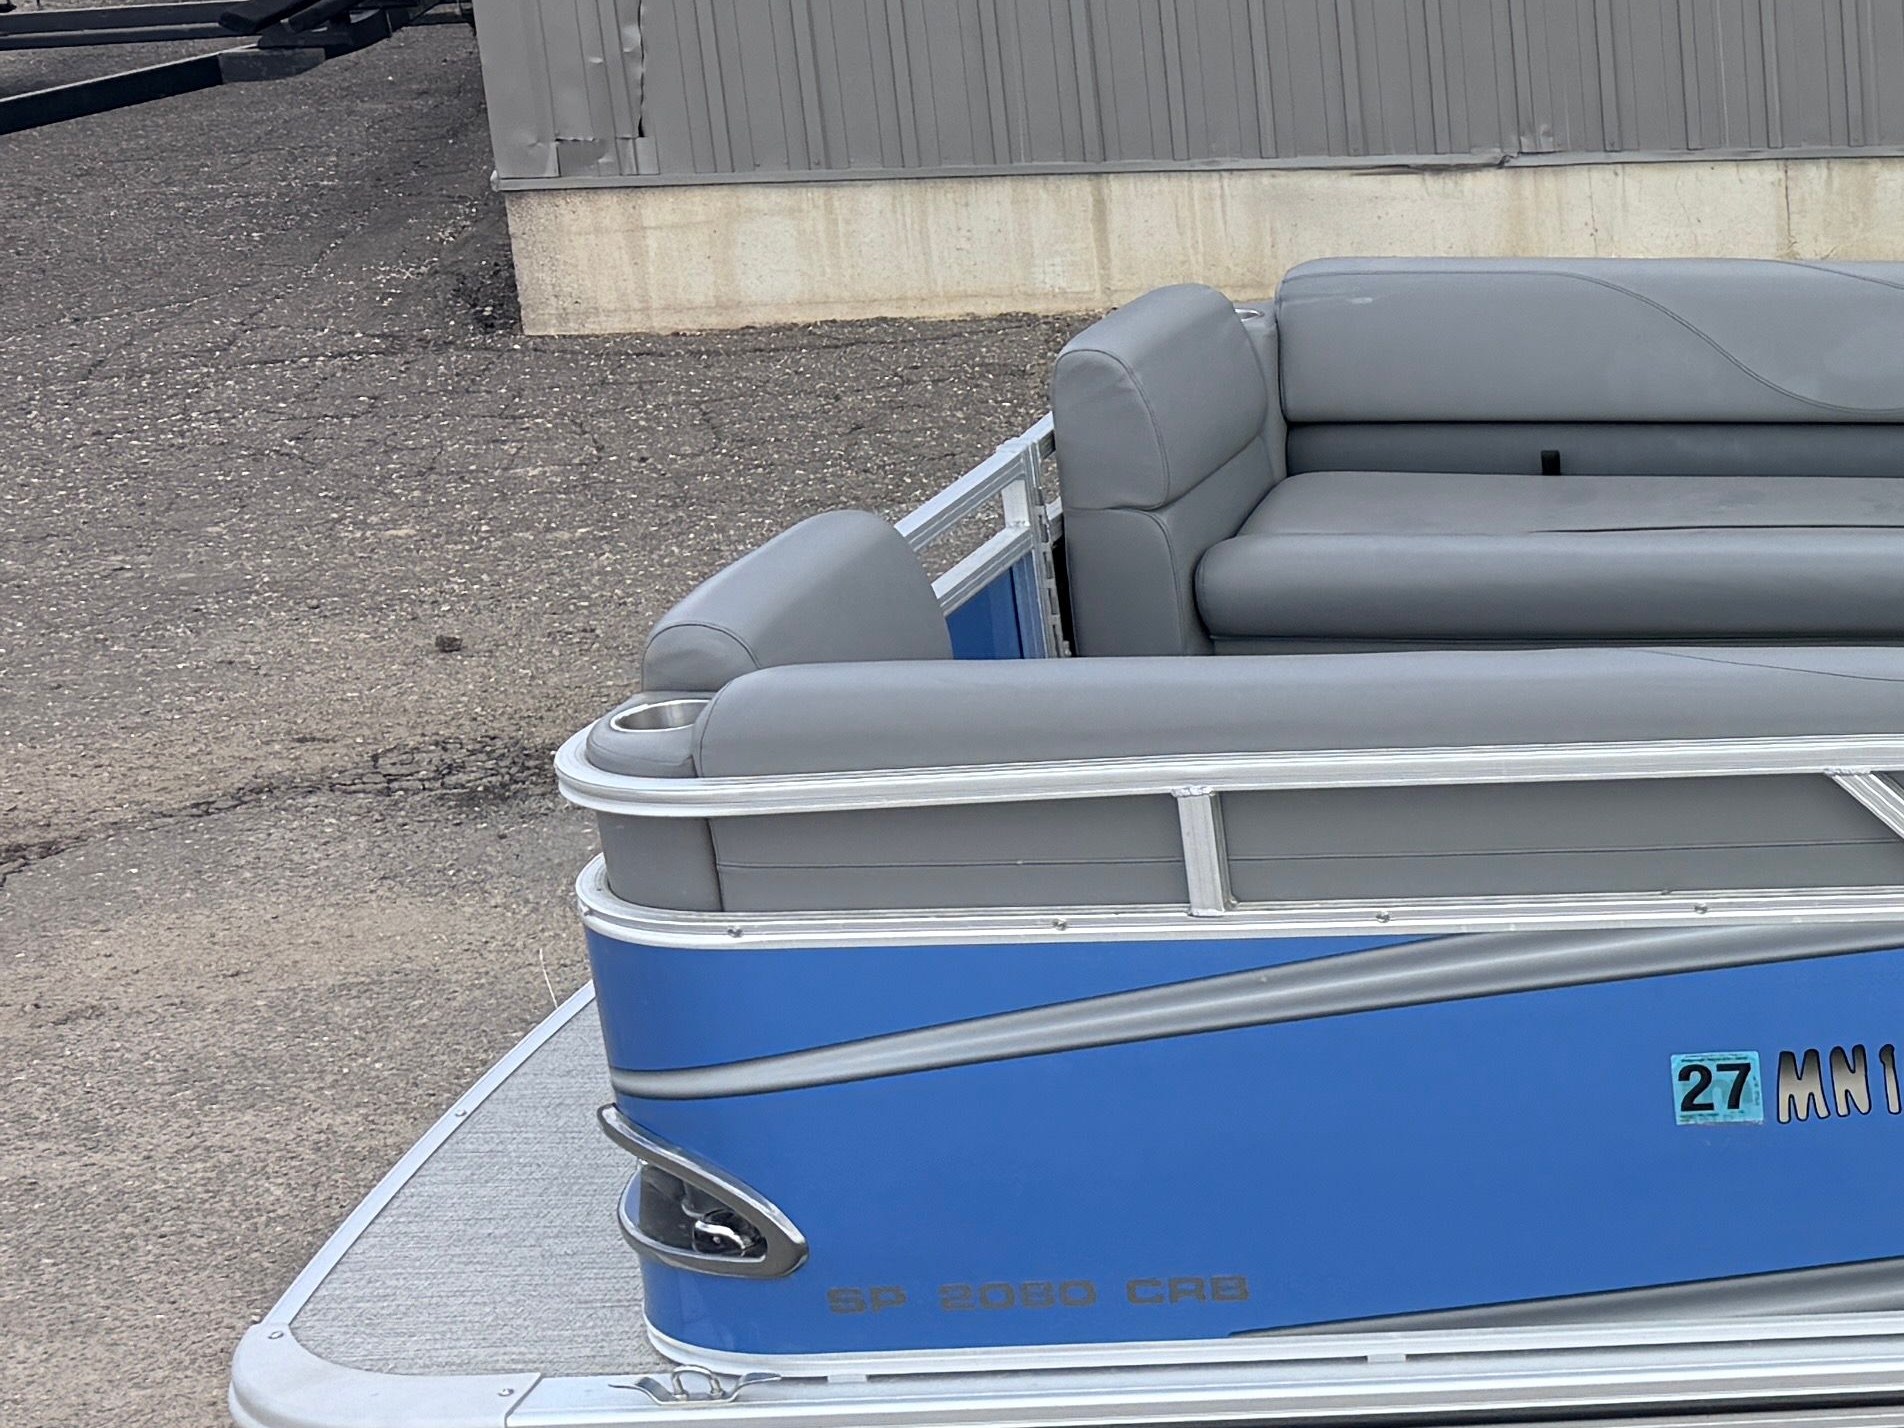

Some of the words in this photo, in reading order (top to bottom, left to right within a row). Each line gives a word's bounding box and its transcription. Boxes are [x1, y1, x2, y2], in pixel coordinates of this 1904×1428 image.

[1677, 1062, 1752, 1112] 27
[826, 1286, 906, 1316] SP
[937, 1279, 1098, 1312] 2080
[1125, 1274, 1251, 1307] CRB
